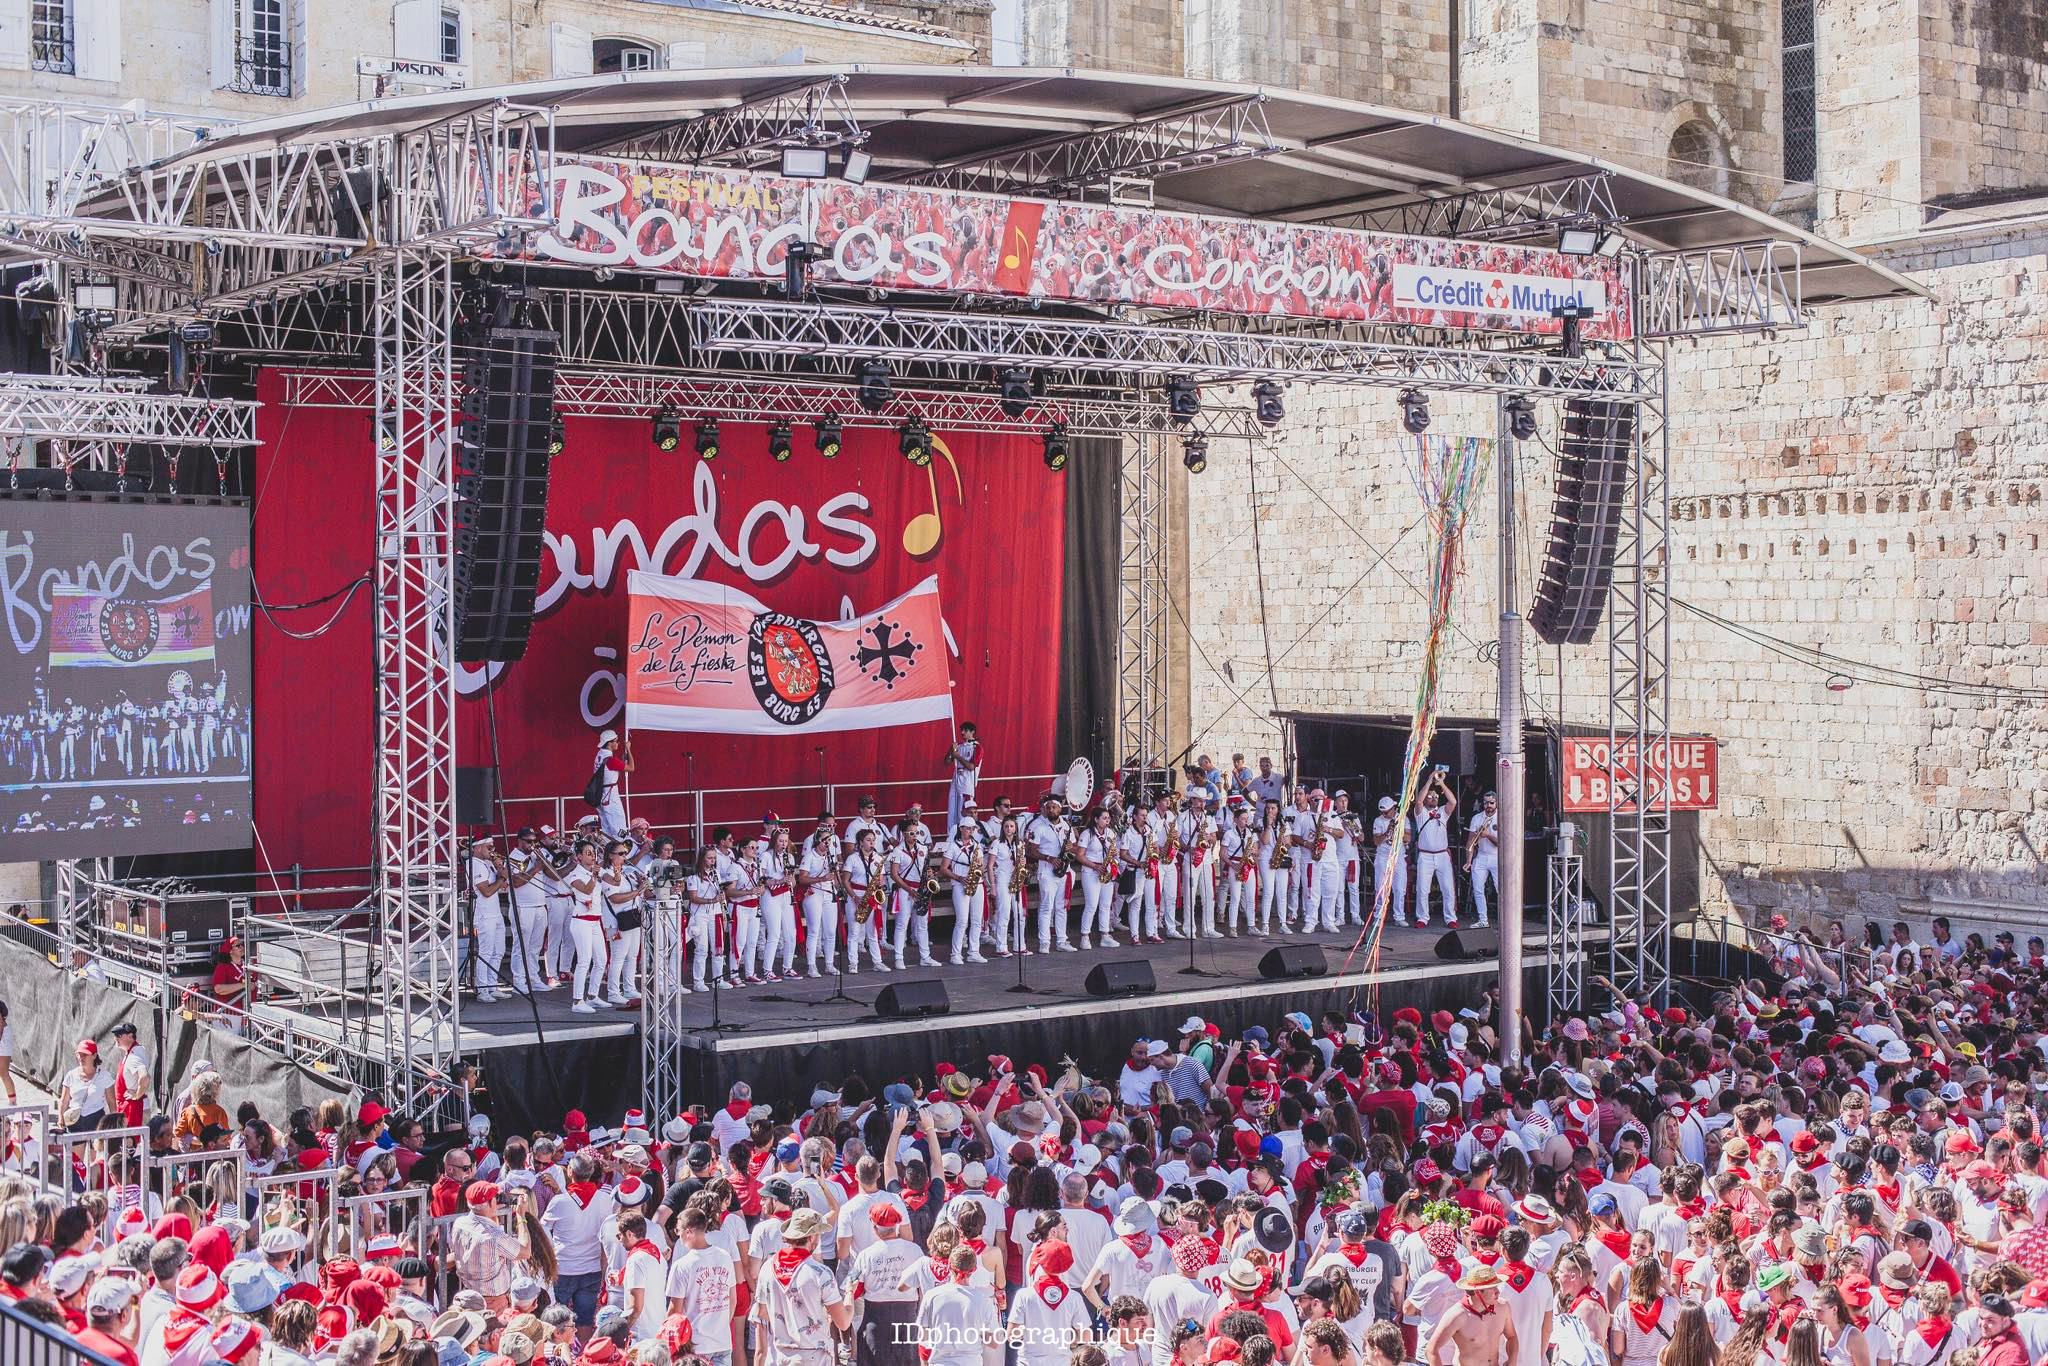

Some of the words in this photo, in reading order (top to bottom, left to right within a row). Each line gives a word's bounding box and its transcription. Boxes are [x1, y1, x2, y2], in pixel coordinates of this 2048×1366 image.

[386, 61, 444, 77] JMSON
[632, 175, 780, 213] FESTIVAL
[531, 163, 951, 286] Bandas
[1143, 242, 1373, 300] Condom
[1416, 275, 1484, 308] Crédit
[1512, 284, 1584, 313] Mutuel
[631, 613, 664, 653] Le
[666, 615, 744, 654] Démon
[110, 644, 134, 660] BURG
[640, 652, 667, 672] de
[669, 654, 686, 672] la
[674, 647, 747, 692] fiesta
[750, 651, 768, 687] LES
[764, 693, 801, 722] BURG
[806, 693, 821, 717] 65
